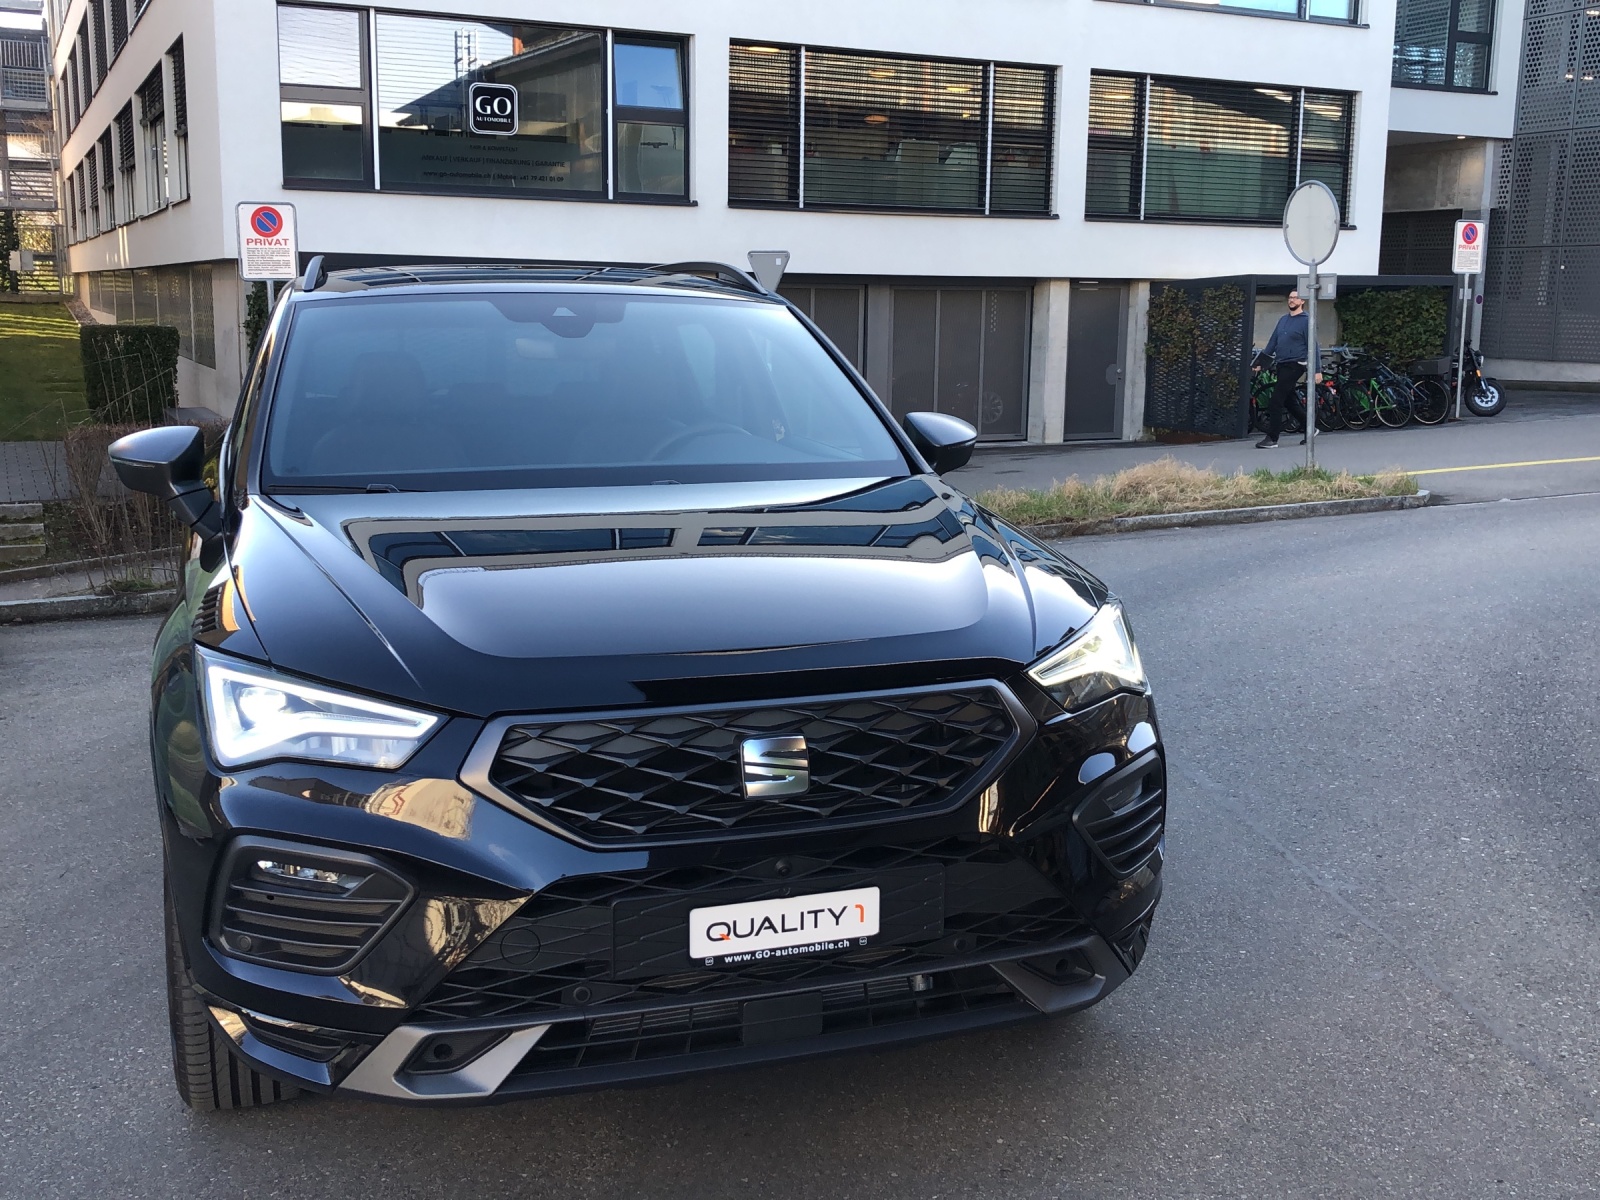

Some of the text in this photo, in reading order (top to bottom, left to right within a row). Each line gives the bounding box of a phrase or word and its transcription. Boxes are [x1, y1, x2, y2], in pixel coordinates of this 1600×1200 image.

[475, 95, 512, 115] GO
[246, 238, 289, 246] PRIVAT
[706, 903, 865, 942] QUALITY 1
[724, 939, 850, 964] www.GO-automobile.ch
